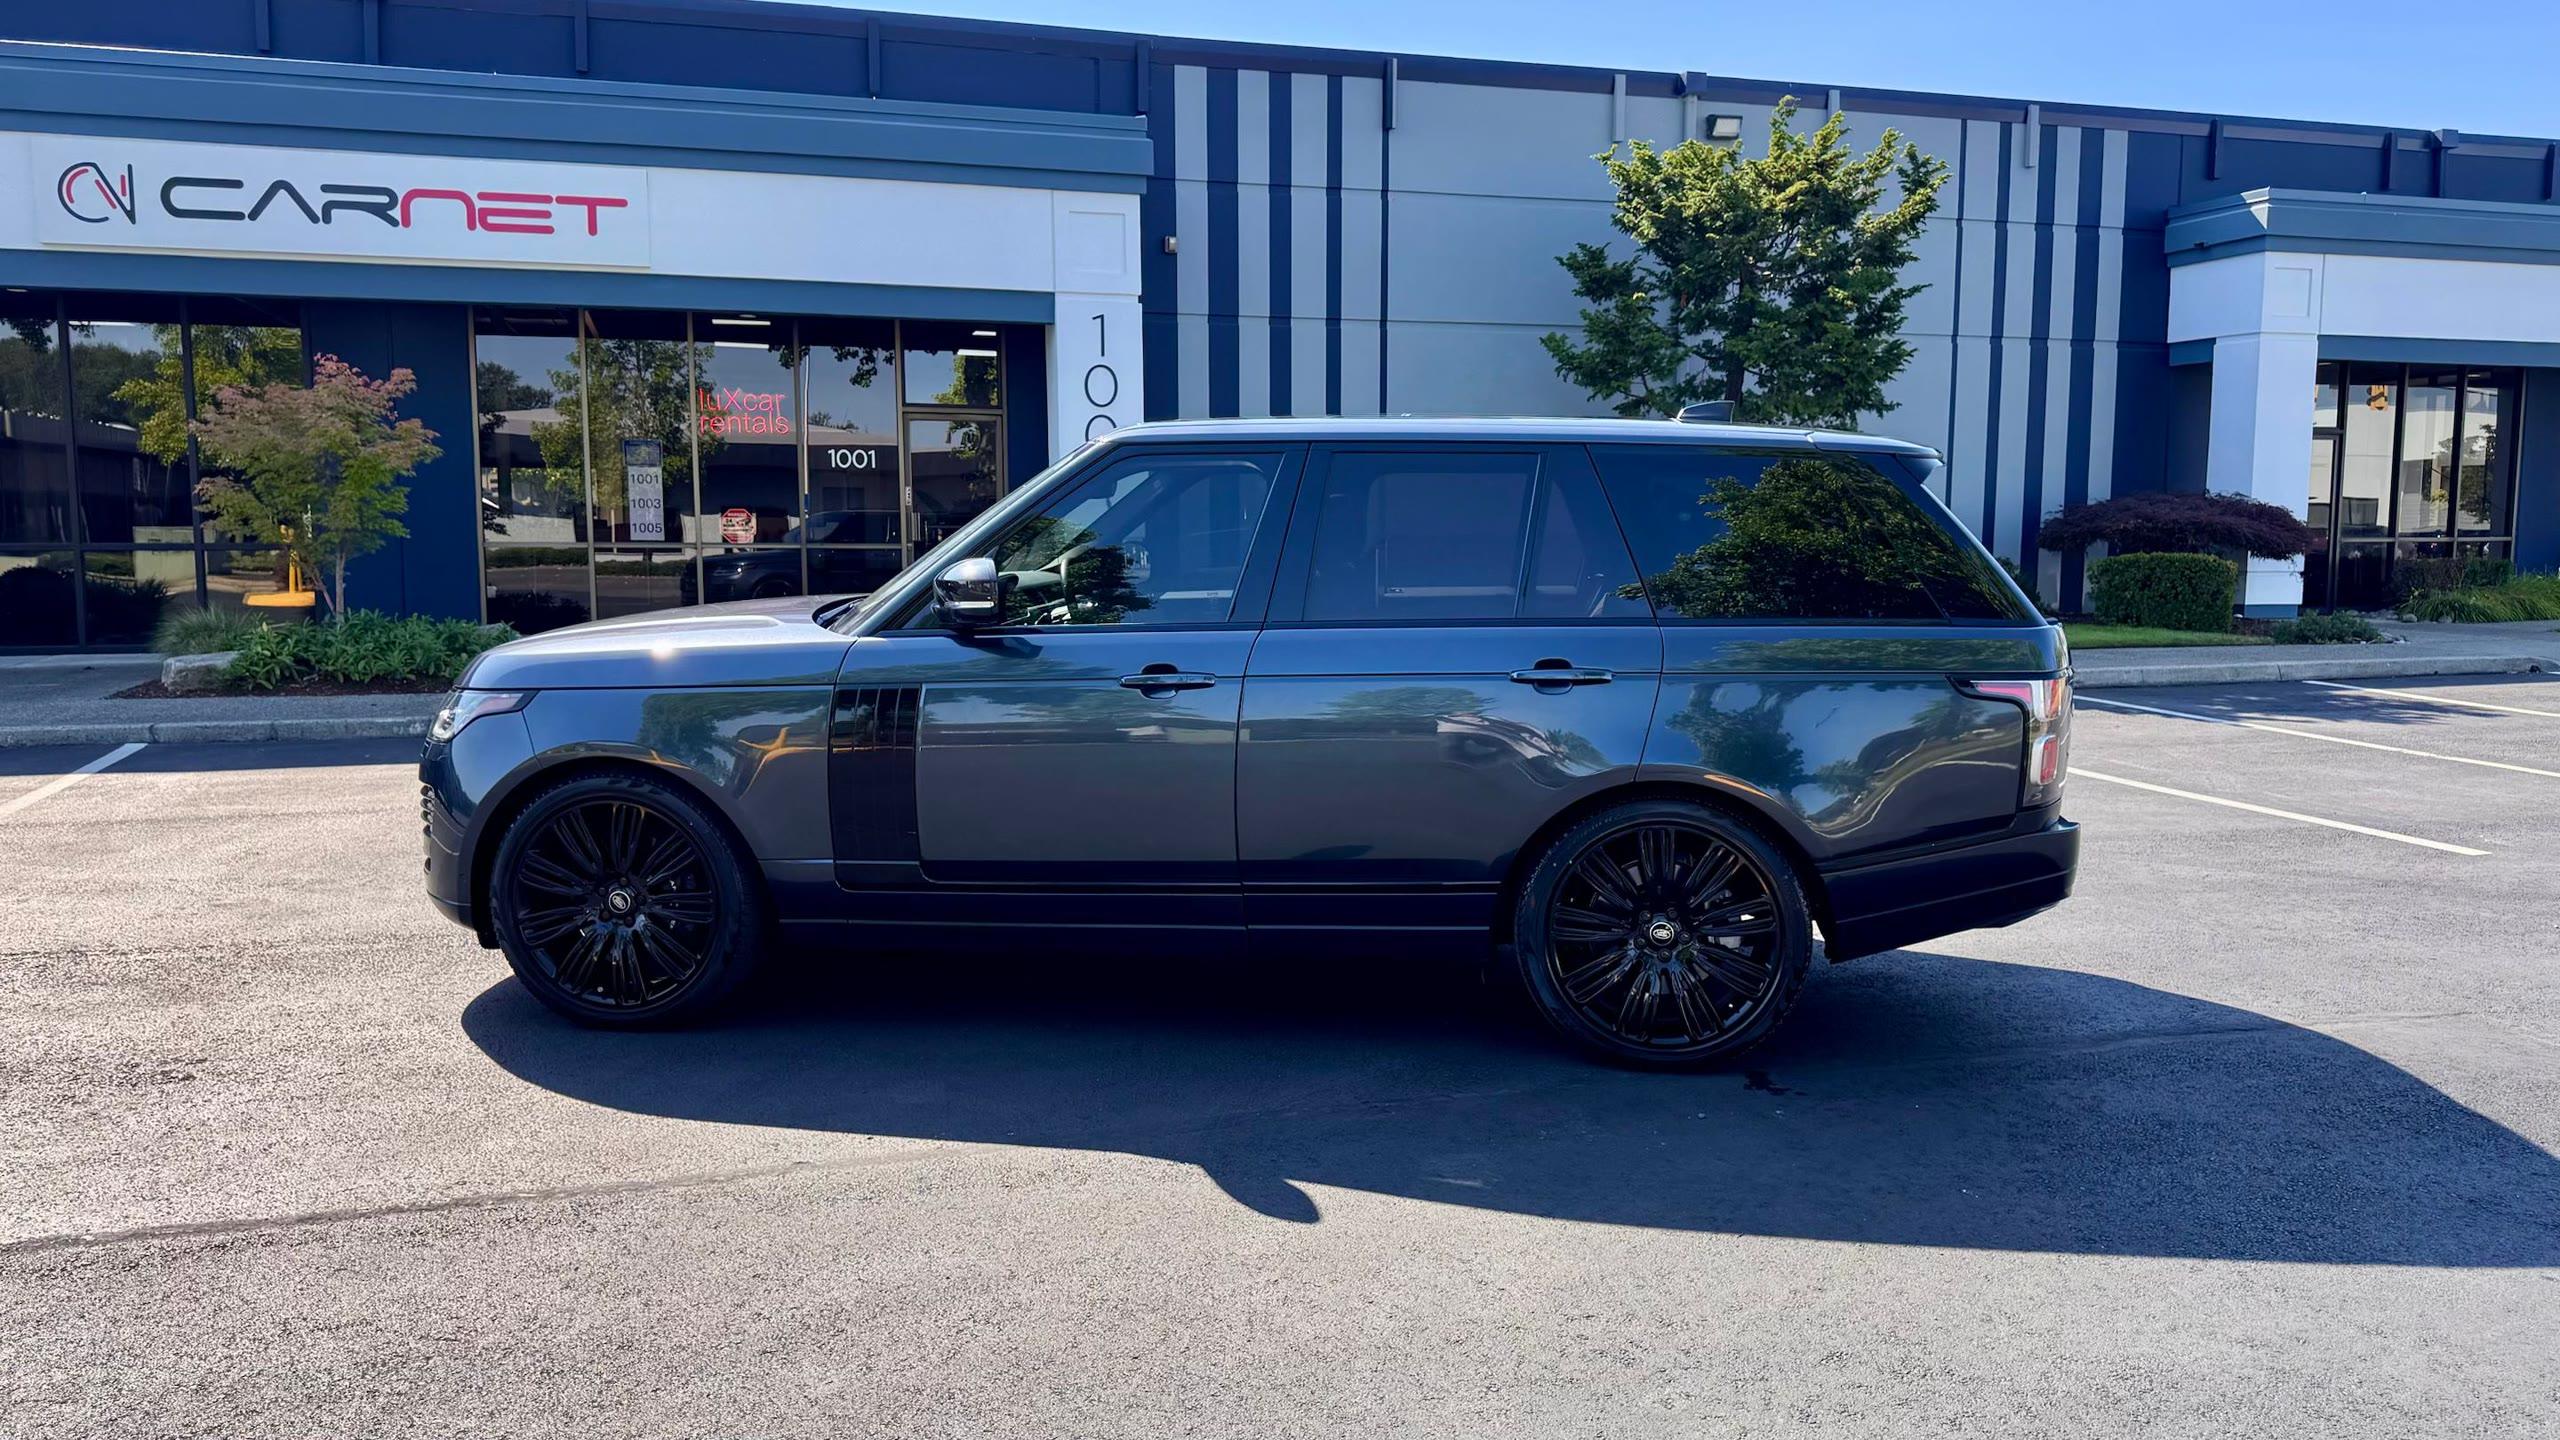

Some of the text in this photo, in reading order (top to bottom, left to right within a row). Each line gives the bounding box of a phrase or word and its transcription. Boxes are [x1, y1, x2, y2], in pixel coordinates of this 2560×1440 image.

[160, 176, 628, 236] CARNET
[699, 411, 790, 435] rentals
[827, 449, 877, 469] 1001
[631, 473, 660, 485] 1001
[631, 498, 661, 509] 1003
[632, 522, 663, 534] 1005
